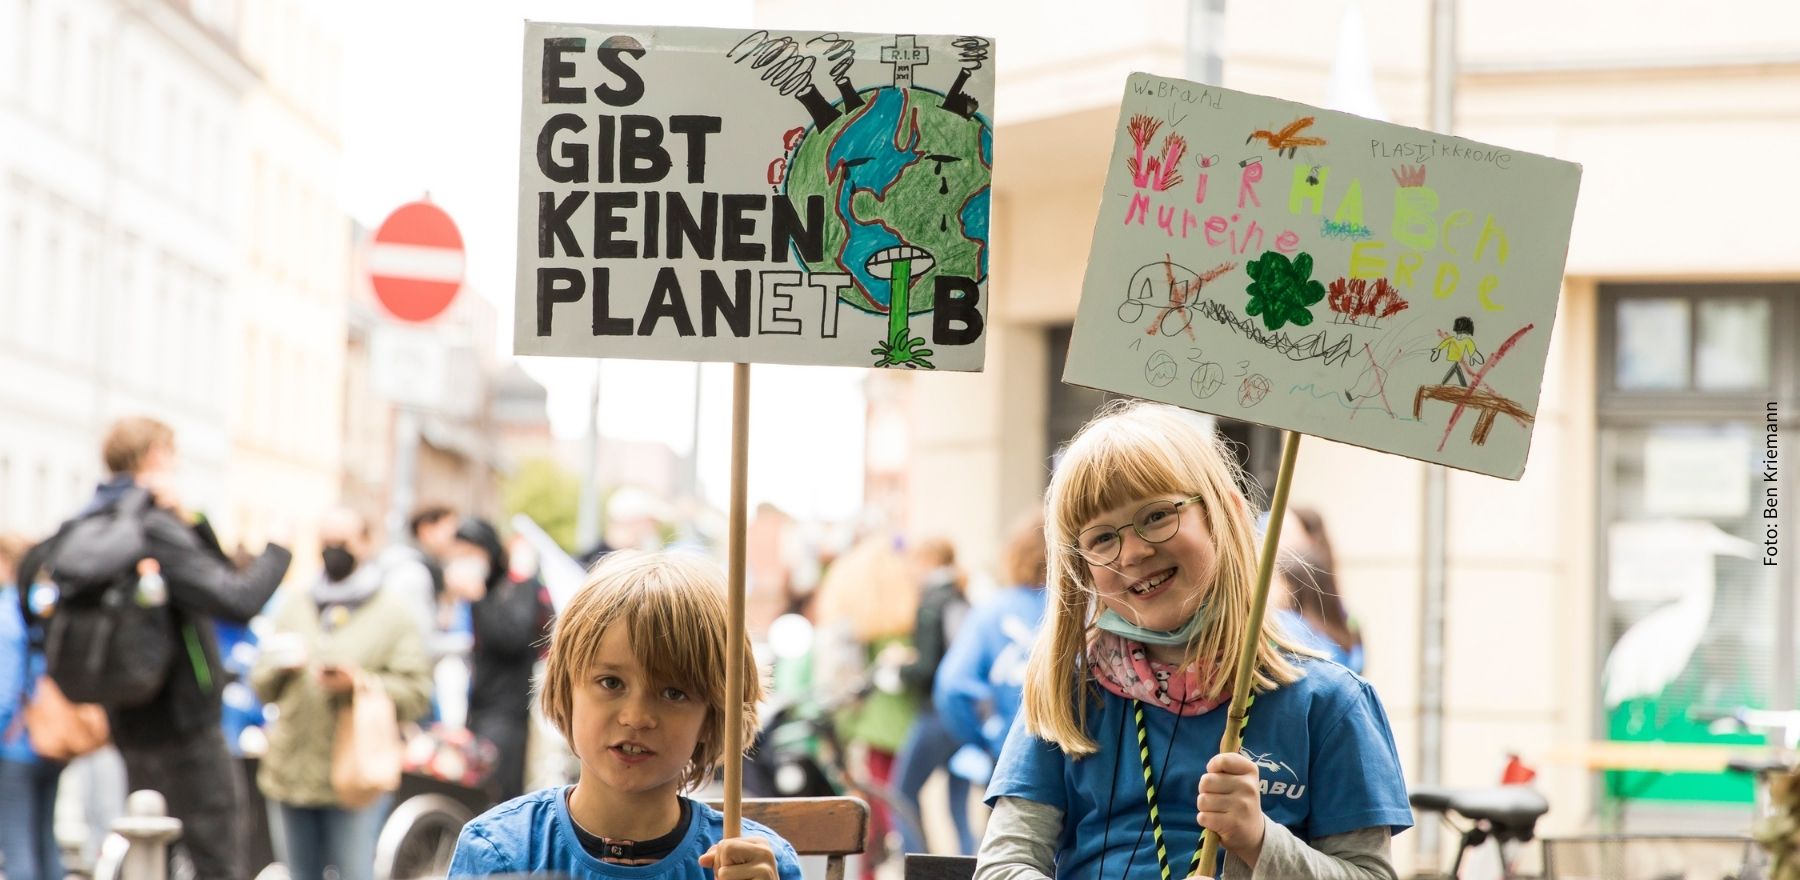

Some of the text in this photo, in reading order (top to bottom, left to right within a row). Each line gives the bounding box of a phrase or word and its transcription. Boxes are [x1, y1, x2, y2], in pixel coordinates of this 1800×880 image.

[542, 35, 647, 107] ES
[536, 113, 722, 184] GIBT
[538, 191, 824, 263] KEINEN
[537, 267, 985, 346] PLANET B
[1258, 779, 1306, 800] ABU
